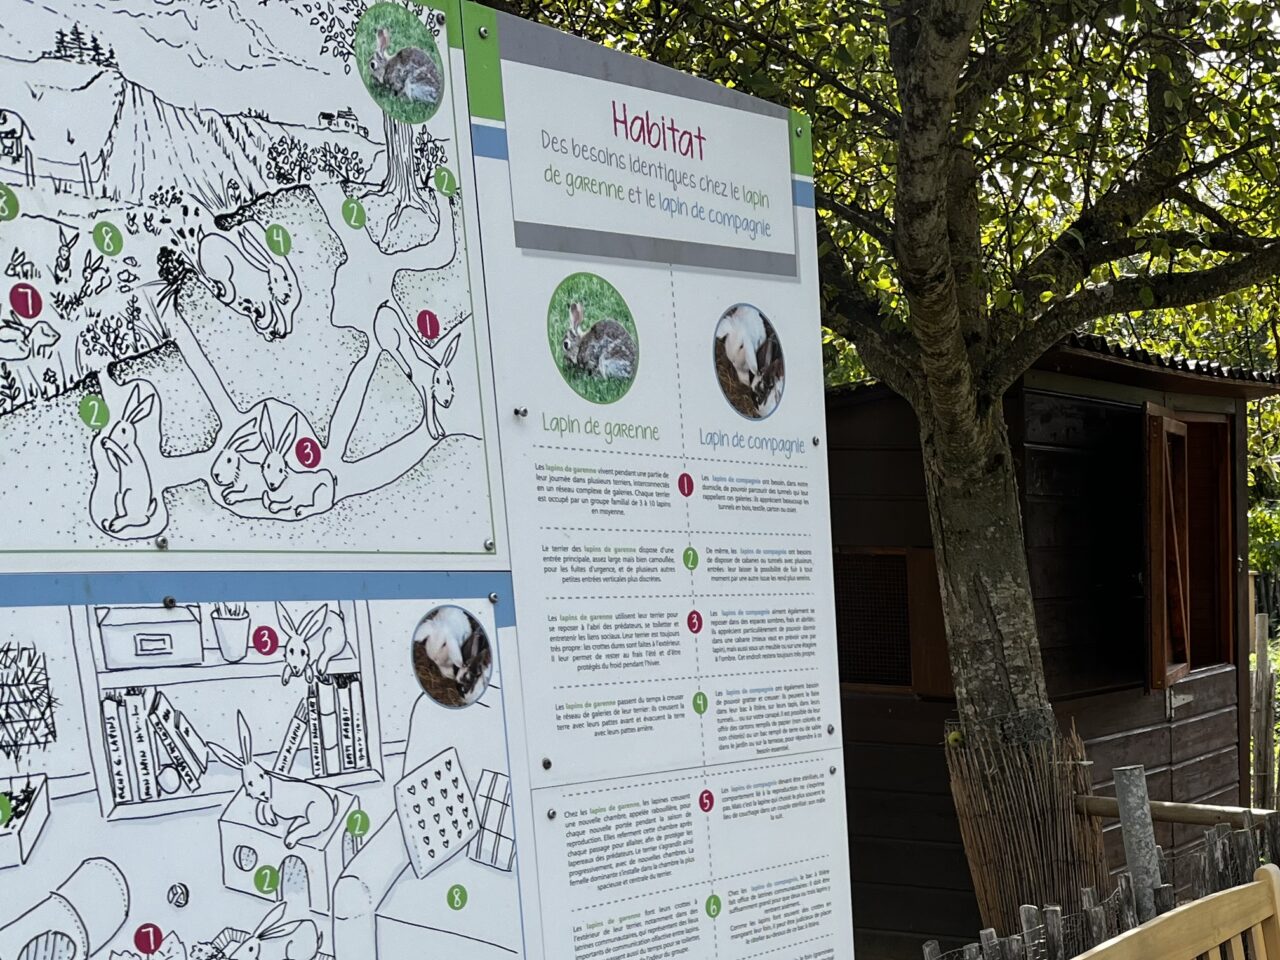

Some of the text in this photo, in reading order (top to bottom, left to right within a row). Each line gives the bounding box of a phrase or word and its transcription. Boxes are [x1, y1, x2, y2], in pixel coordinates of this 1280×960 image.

[612, 100, 707, 161] Habitat
[541, 129, 770, 210] Des besoins identiques chez le lapin
[440, 171, 450, 193] 2
[544, 163, 772, 241] de garenne et le lapin de compagnie
[349, 203, 359, 225] 2
[102, 226, 114, 252] 8
[273, 228, 284, 253] 4
[17, 288, 32, 315] 7
[424, 314, 431, 337] 1
[89, 400, 101, 425] 2
[542, 412, 661, 445] Lapin de garenne
[303, 441, 314, 465] 3
[699, 427, 806, 460] Lapin de compagnie
[683, 475, 688, 495] 1
[687, 550, 694, 568] 2
[691, 613, 699, 630] 3
[260, 629, 272, 653] 3
[697, 694, 705, 711] 4
[702, 792, 710, 811] 5
[353, 813, 363, 834] 2
[262, 869, 273, 890] 2
[452, 888, 462, 908] 8
[710, 898, 718, 915] 6
[141, 928, 155, 950] 7
